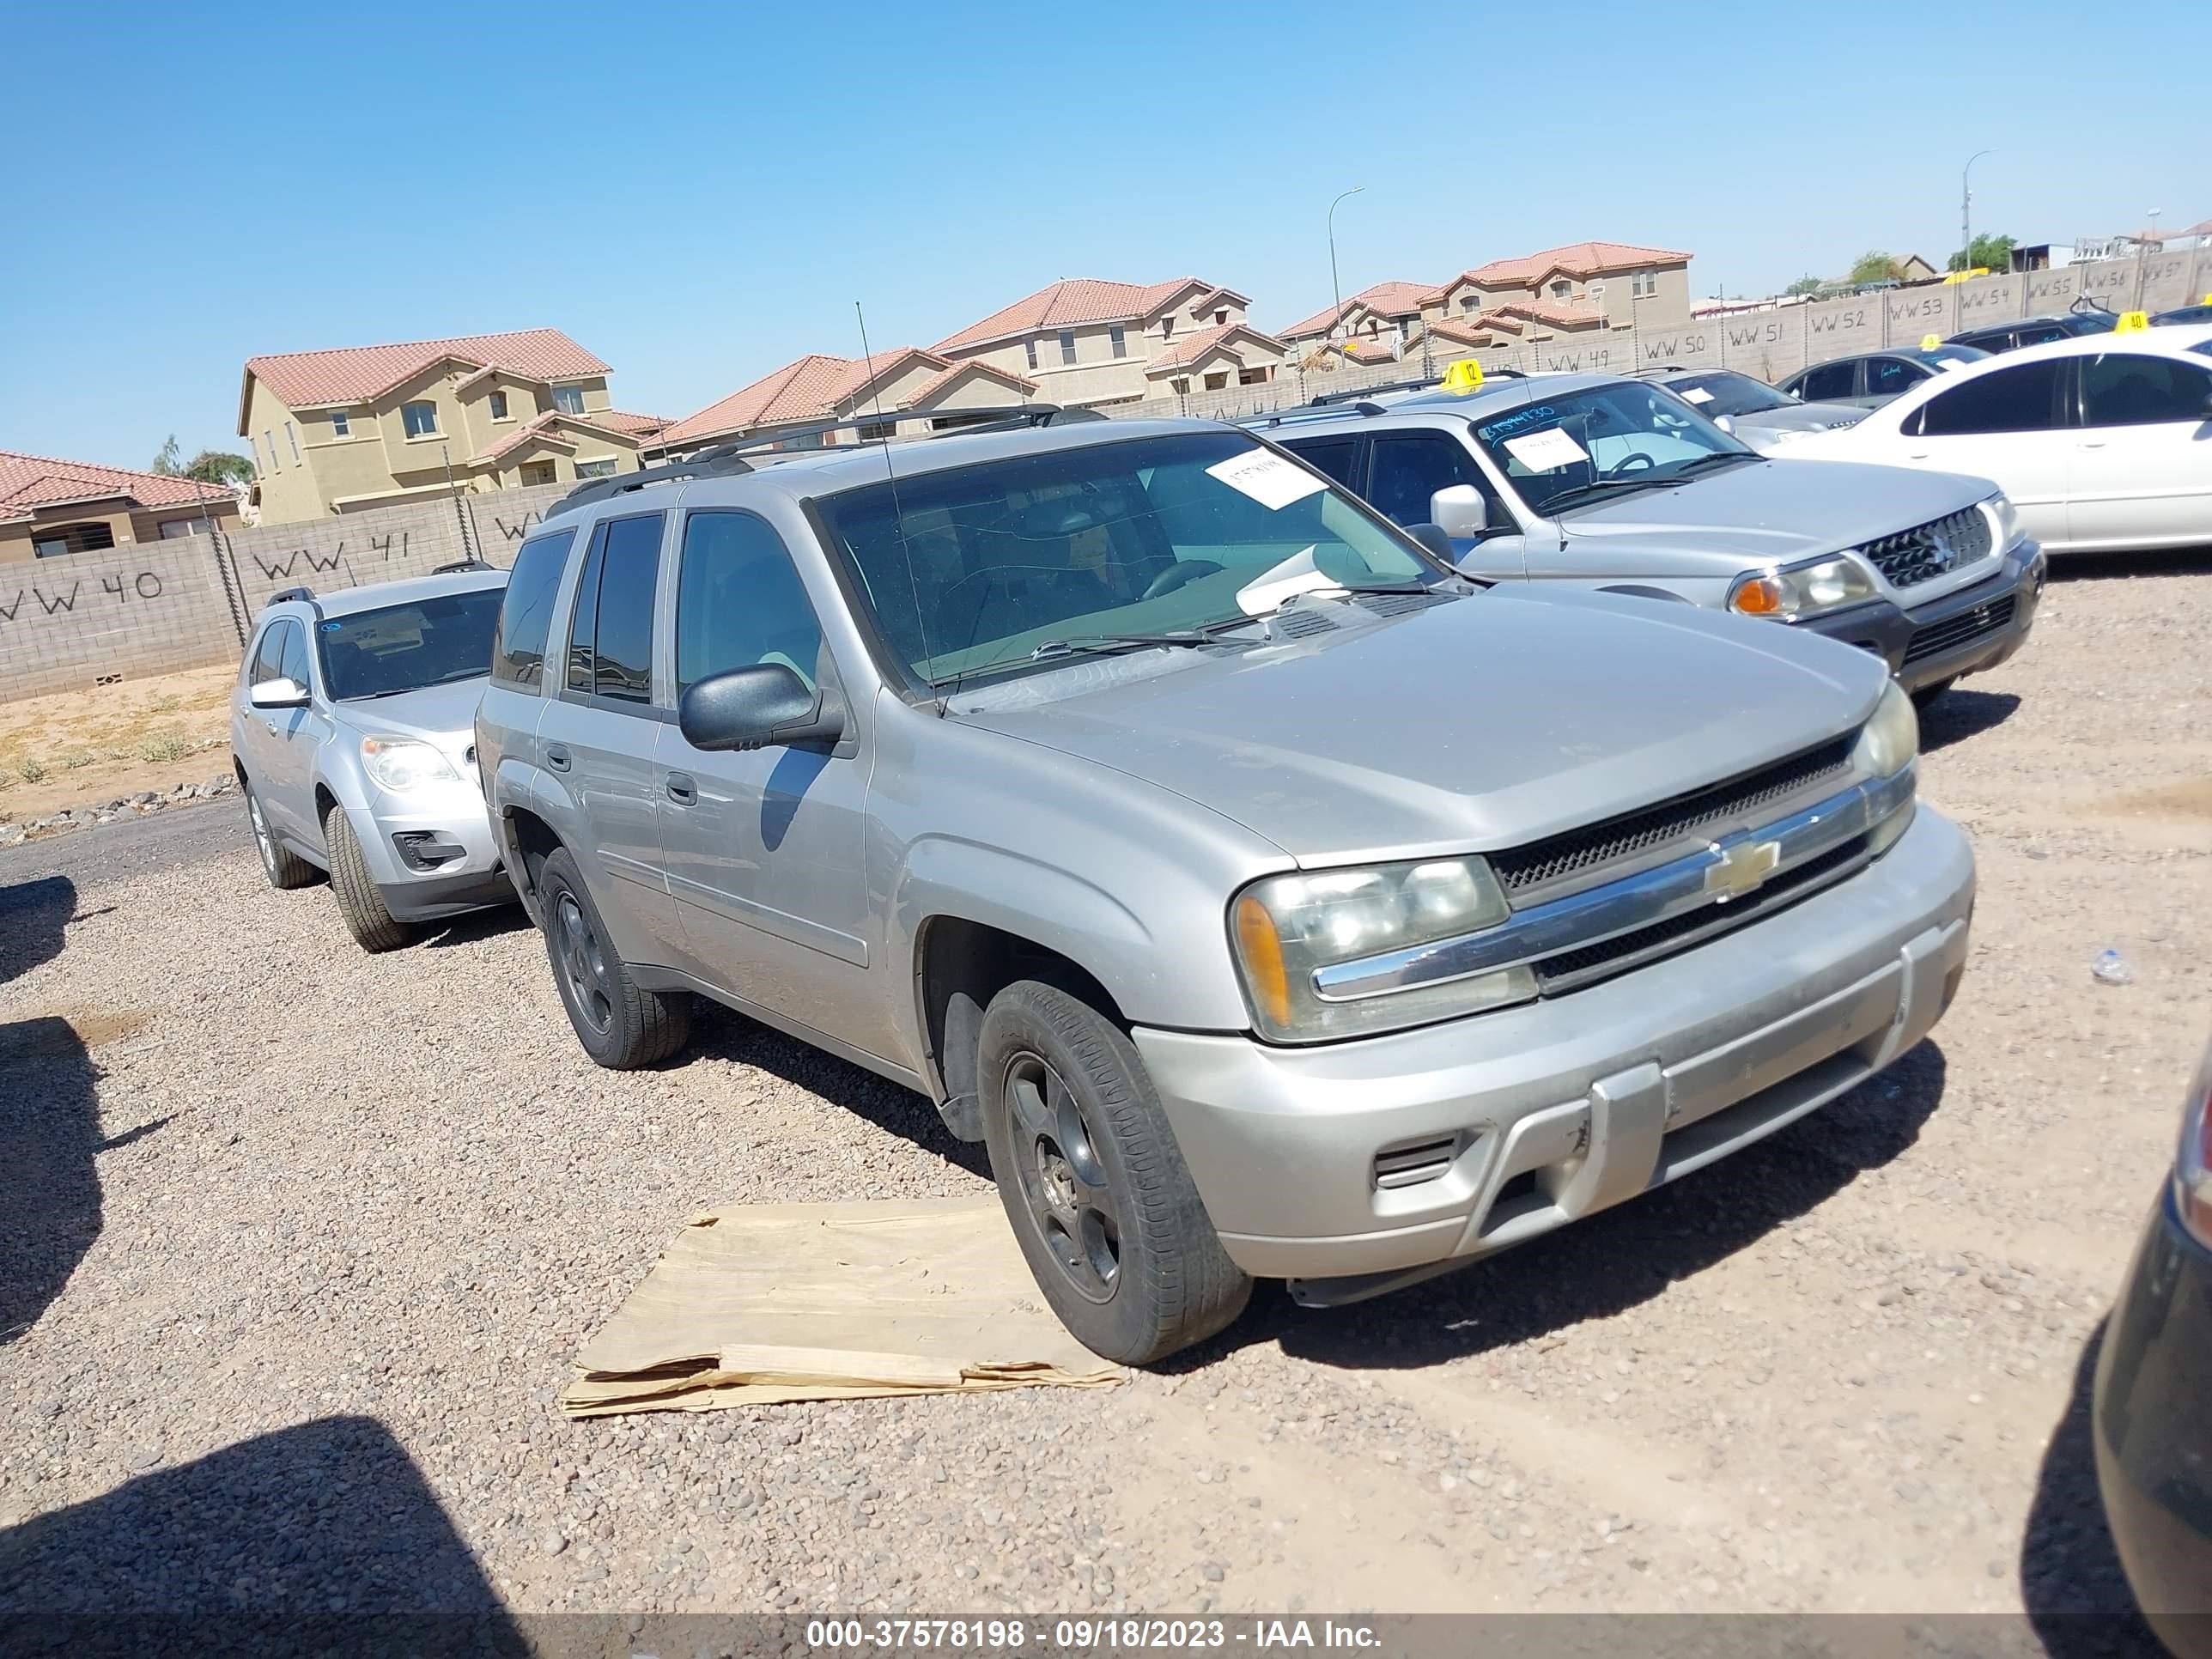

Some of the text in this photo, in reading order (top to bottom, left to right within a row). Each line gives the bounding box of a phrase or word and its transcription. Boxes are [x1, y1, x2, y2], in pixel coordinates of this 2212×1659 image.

[2028, 278, 2071, 298] WW 55
[2110, 270, 2125, 286] 56
[1890, 298, 1942, 321] WW 53
[1961, 289, 2009, 310] WW 54
[1811, 311, 1866, 333] WW 52
[1729, 323, 1784, 346] WW 51
[1644, 336, 1705, 358] WW 50
[1548, 350, 1608, 371] WW 49
[1466, 363, 1477, 381] 12
[495, 512, 543, 540] W
[253, 532, 408, 580] WW 41
[102, 572, 162, 603] 40
